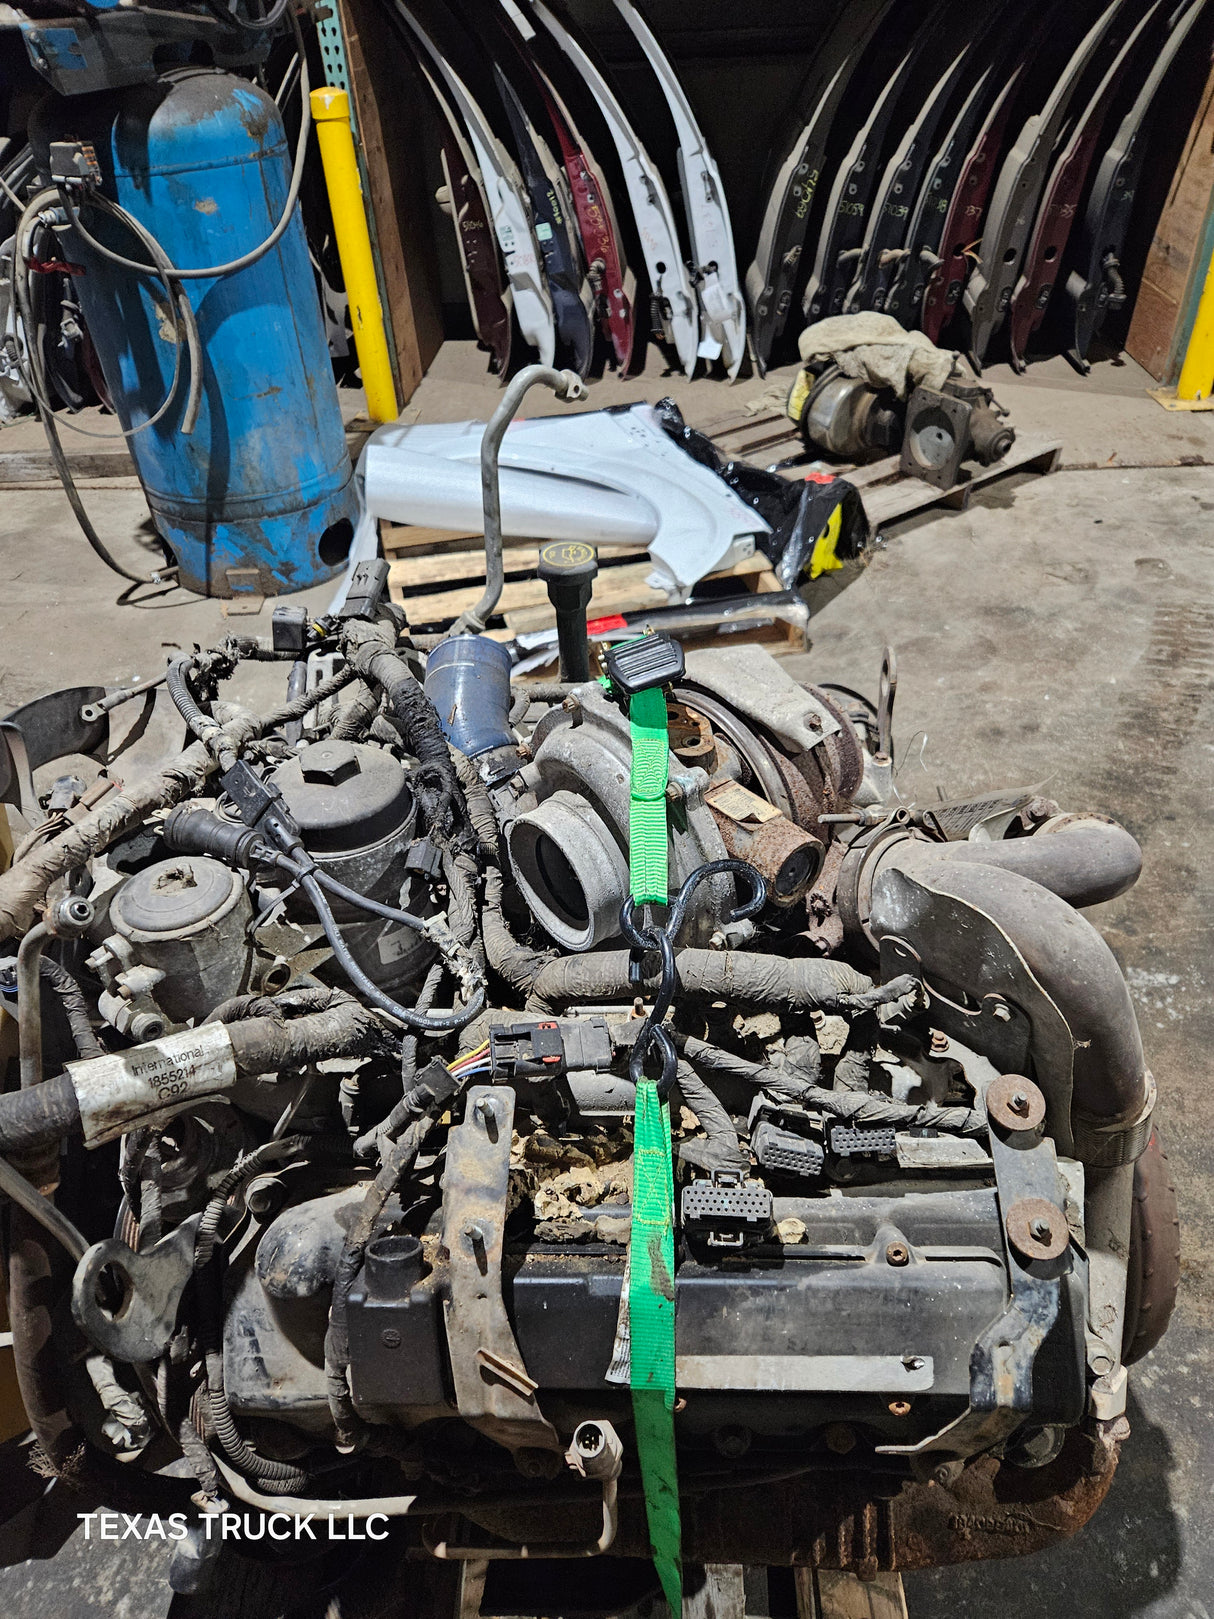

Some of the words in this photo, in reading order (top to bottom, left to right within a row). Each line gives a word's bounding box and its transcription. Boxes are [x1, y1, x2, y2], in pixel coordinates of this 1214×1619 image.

[338, 938, 351, 958] WATER
[349, 960, 374, 991] RESISTANT
[131, 1045, 204, 1077] International
[148, 1064, 196, 1088] 1855214
[158, 1081, 189, 1100] C92
